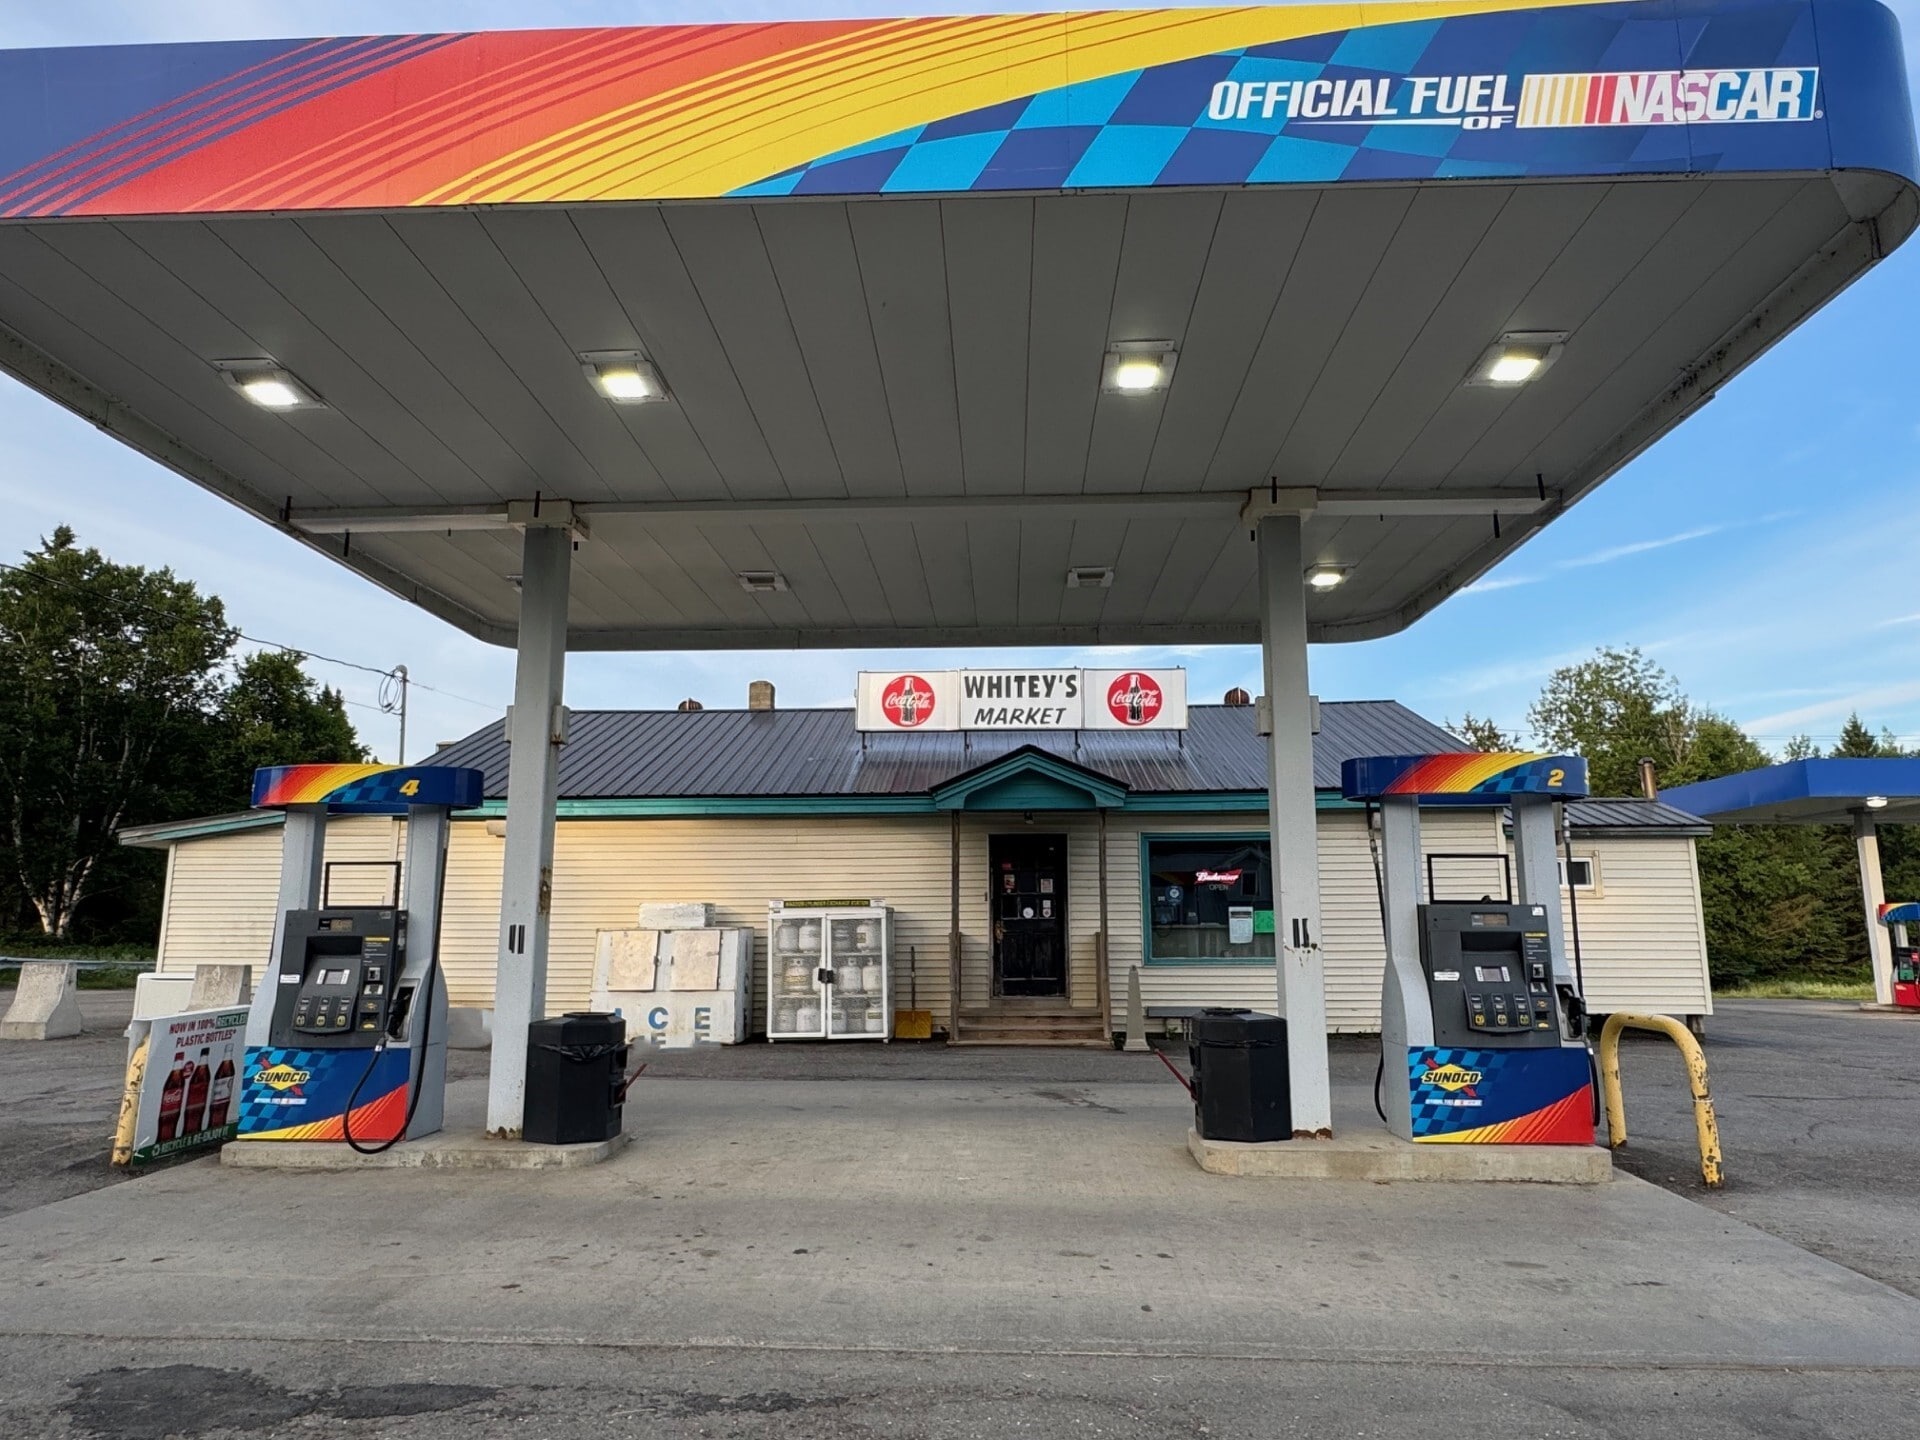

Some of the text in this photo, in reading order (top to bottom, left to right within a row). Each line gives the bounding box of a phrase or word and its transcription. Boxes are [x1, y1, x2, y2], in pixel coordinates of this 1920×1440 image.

[1208, 70, 1804, 131] OFFICIAL FUEL OF NASCAR
[964, 674, 1077, 698] WHITEY'S
[974, 707, 1067, 725] MARKET
[1547, 769, 1565, 787] 2
[399, 779, 420, 796] 4
[169, 1022, 188, 1034] NOW
[188, 1020, 196, 1032] IN
[197, 1018, 215, 1031] 100%
[176, 1033, 204, 1048] PLASTIC
[257, 1071, 308, 1083] SUNOCO
[1423, 1071, 1480, 1083] SUNOCO
